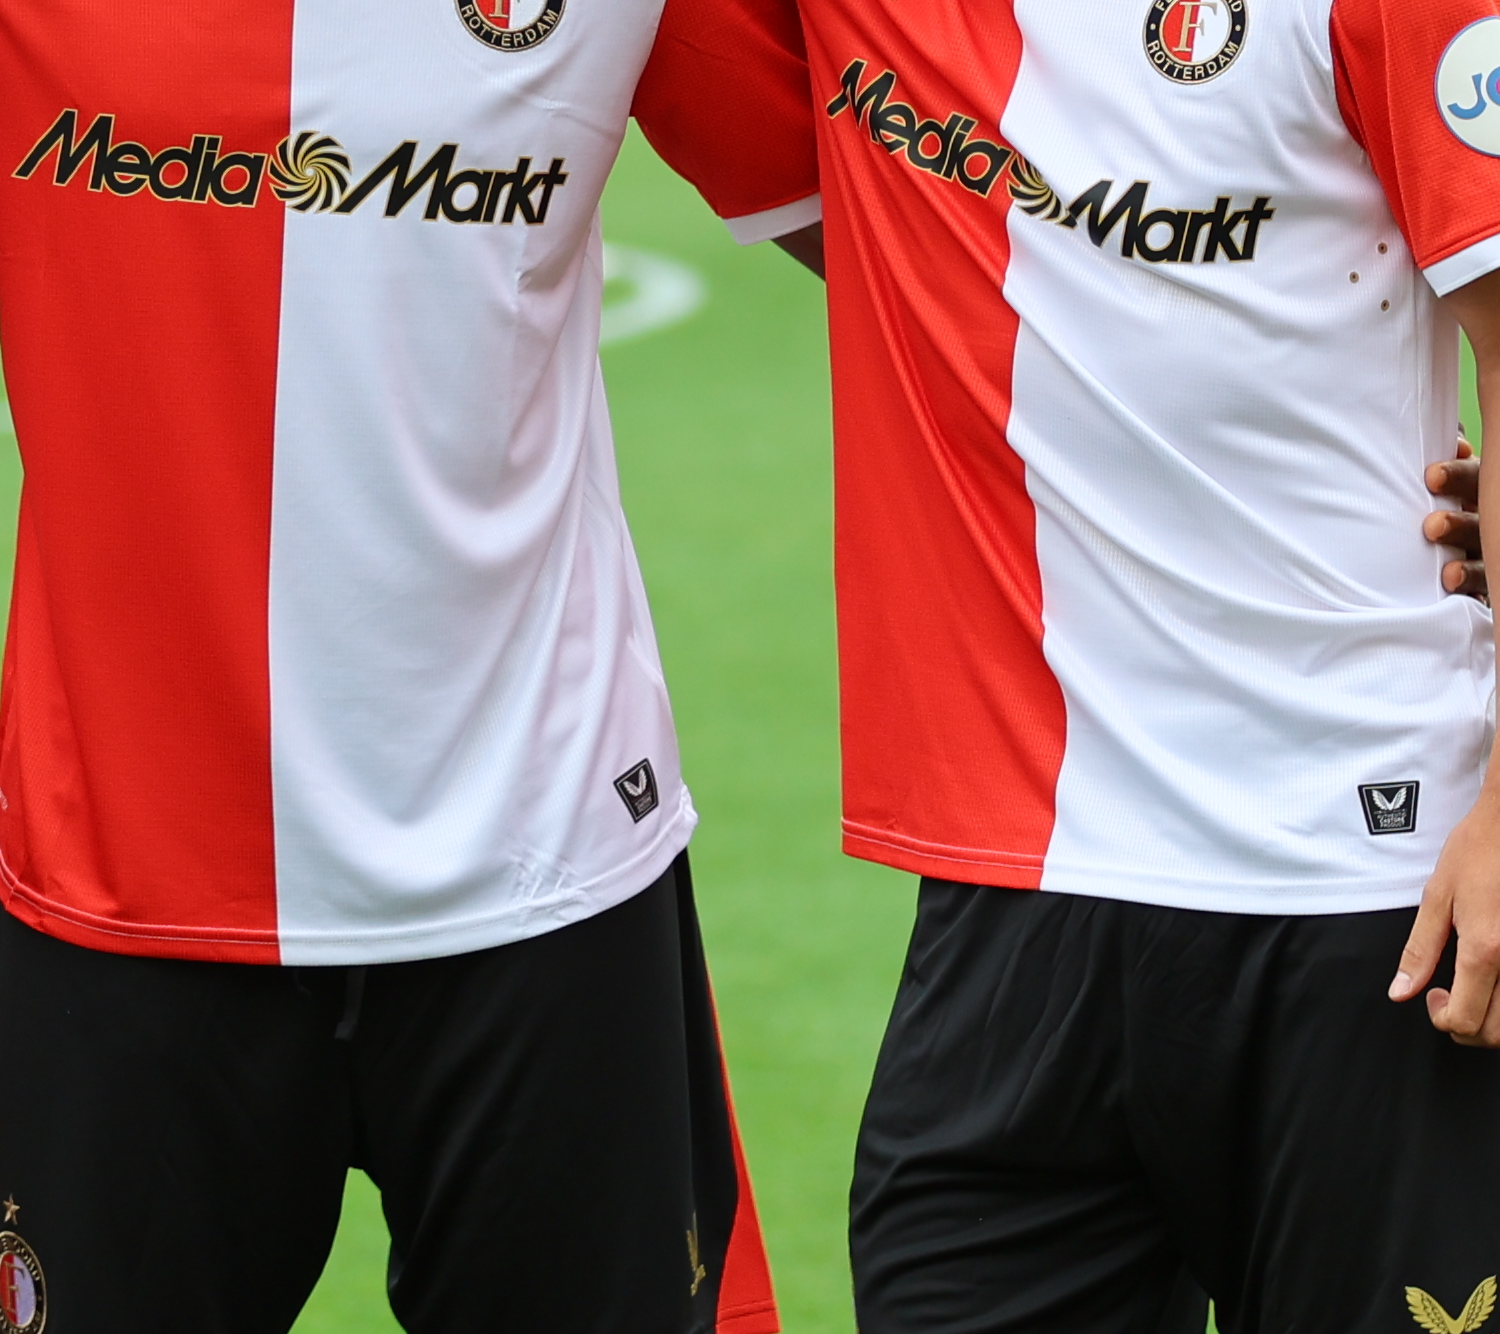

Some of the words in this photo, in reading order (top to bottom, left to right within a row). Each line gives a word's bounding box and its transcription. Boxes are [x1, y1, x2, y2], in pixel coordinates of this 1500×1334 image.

[461, 4, 558, 46] ROTTERDAM
[1172, 1, 1217, 52] F
[1147, 40, 1239, 79] ROTTERDAM
[12, 108, 270, 207] Media
[334, 140, 568, 226] Markt
[826, 58, 1017, 198] Media
[1061, 180, 1277, 264] Markt
